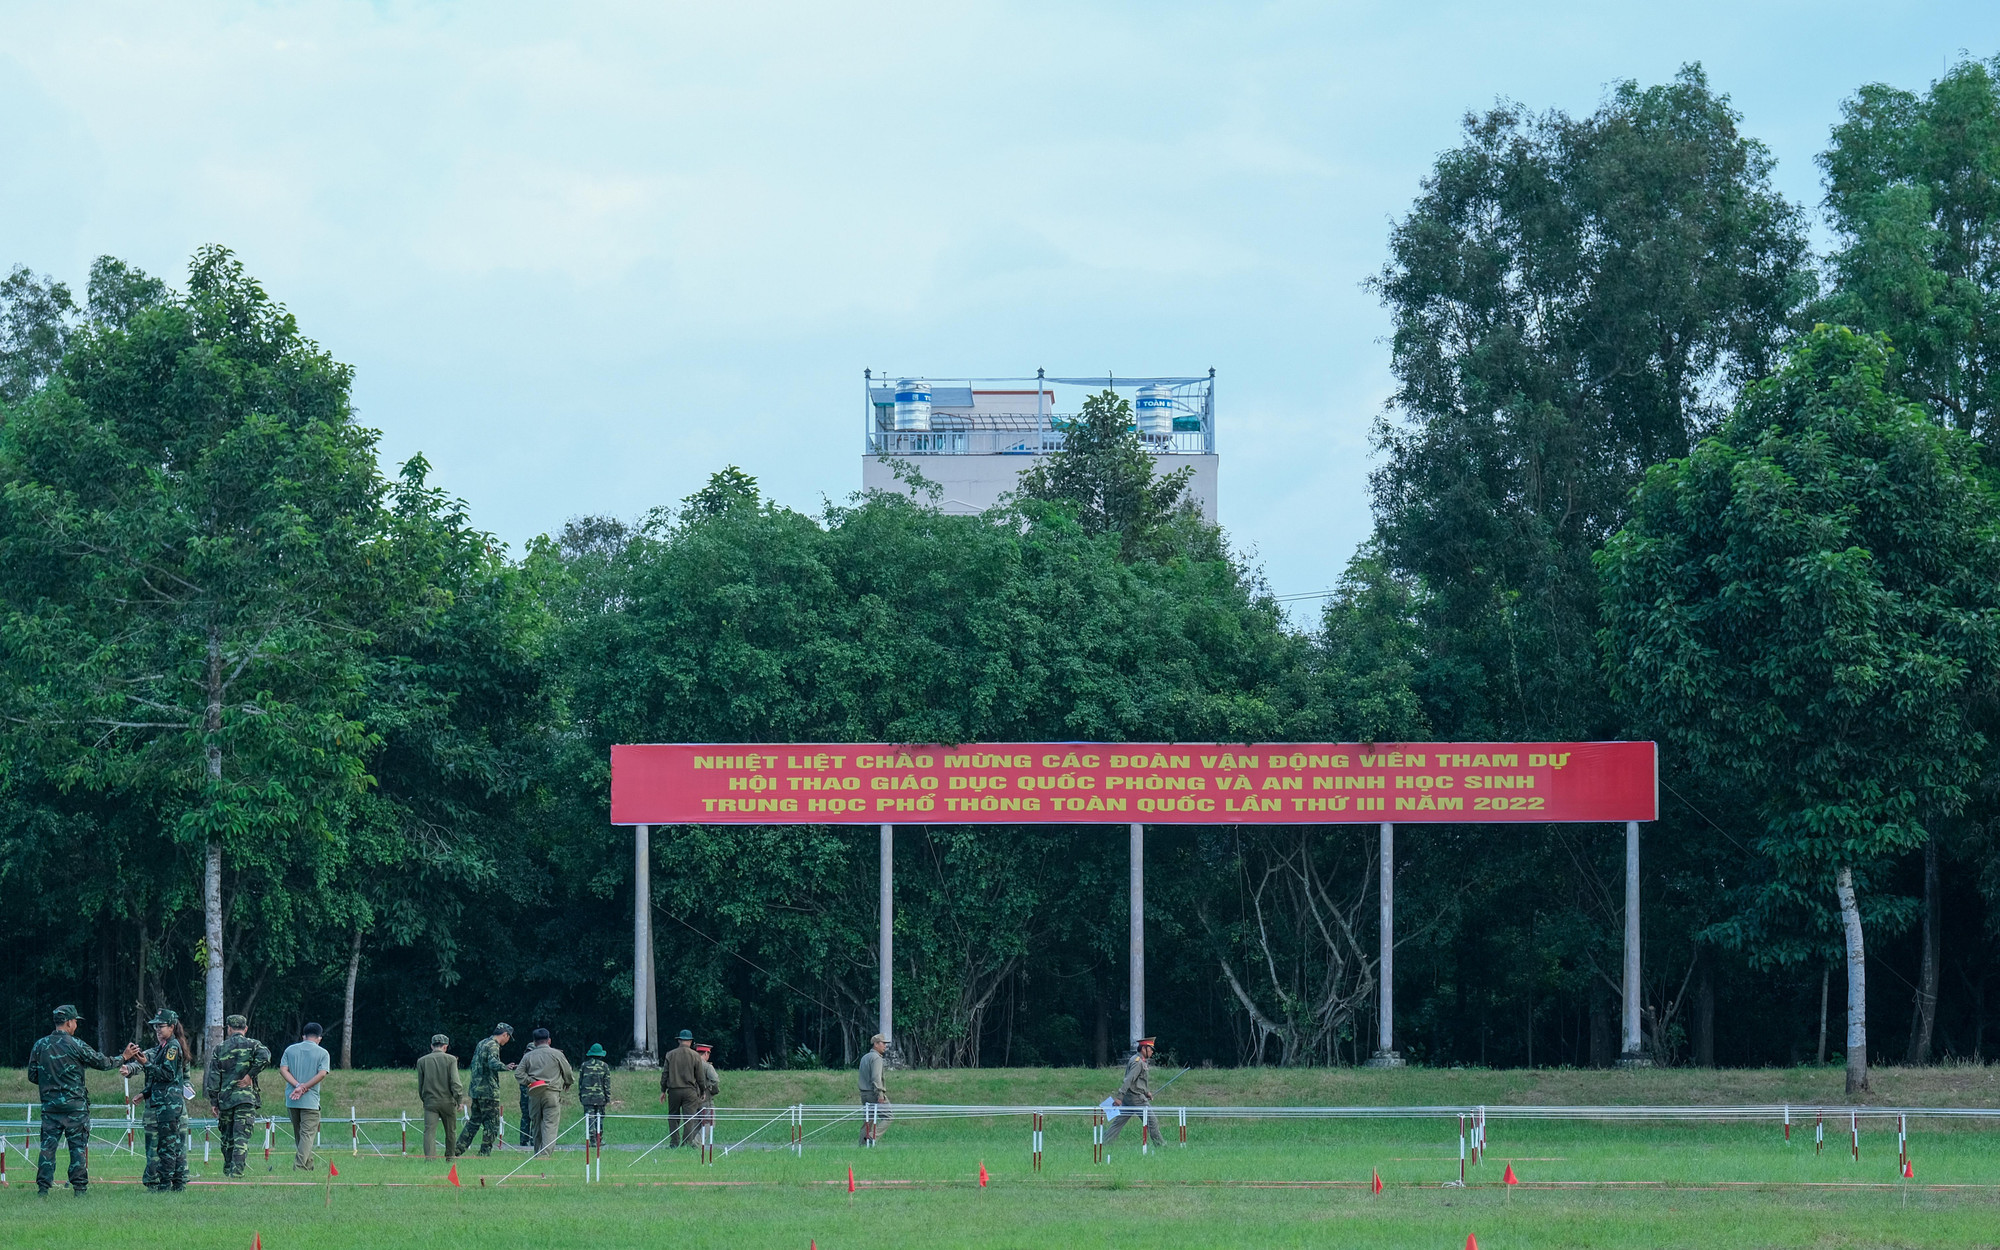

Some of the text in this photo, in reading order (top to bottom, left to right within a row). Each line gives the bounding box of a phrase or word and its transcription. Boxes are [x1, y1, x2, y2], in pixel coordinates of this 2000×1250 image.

[694, 752, 1571, 771] NHIỆT LIỆT CHÀO MỪNG CÁC ĐOÀN VẬN ĐỘNG VIÊN THAM DỰ
[729, 772, 1534, 792] HỘI THAO GIÁO DỤC QUỐC PHÒNG VÀ AN NINH HỌC SINH
[702, 793, 1544, 814] TRUNG HỌC PHỔ THÔNG TOÀN QUỐC LẦN THỨ III NĂM 2022
